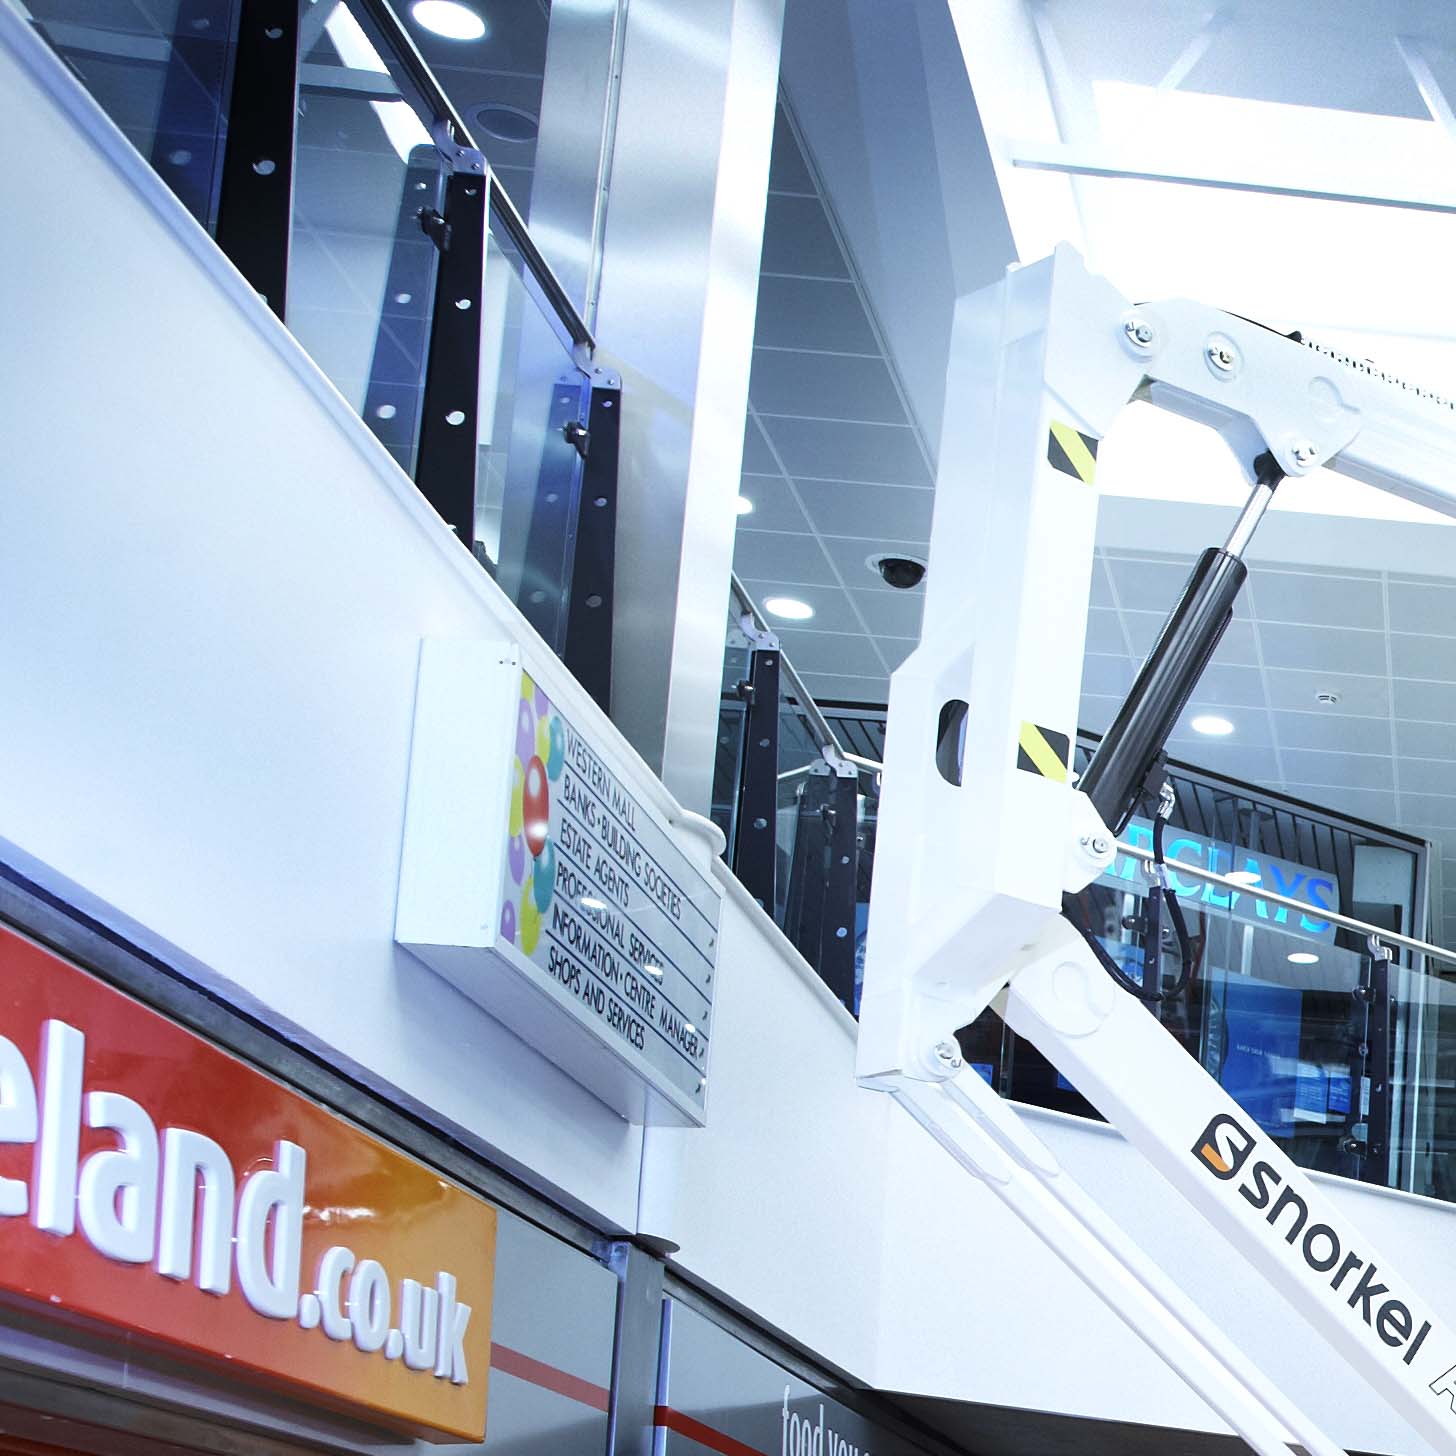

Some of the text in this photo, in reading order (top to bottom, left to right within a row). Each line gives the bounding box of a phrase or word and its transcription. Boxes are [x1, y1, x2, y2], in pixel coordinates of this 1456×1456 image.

[567, 728, 636, 832] WESTERN MALL
[560, 818, 629, 908] ESTATE AGENTS
[564, 773, 681, 921] BANKS BUILDING SOCIETIES
[1104, 823, 1335, 933] RCLAYS
[556, 861, 625, 950] PROFEIONAL
[549, 945, 646, 1051] SHOPS AND SERVICES
[552, 905, 699, 1060] INFORMATION CENTRE MANAGER
[1238, 1161, 1431, 1365] snorkel
